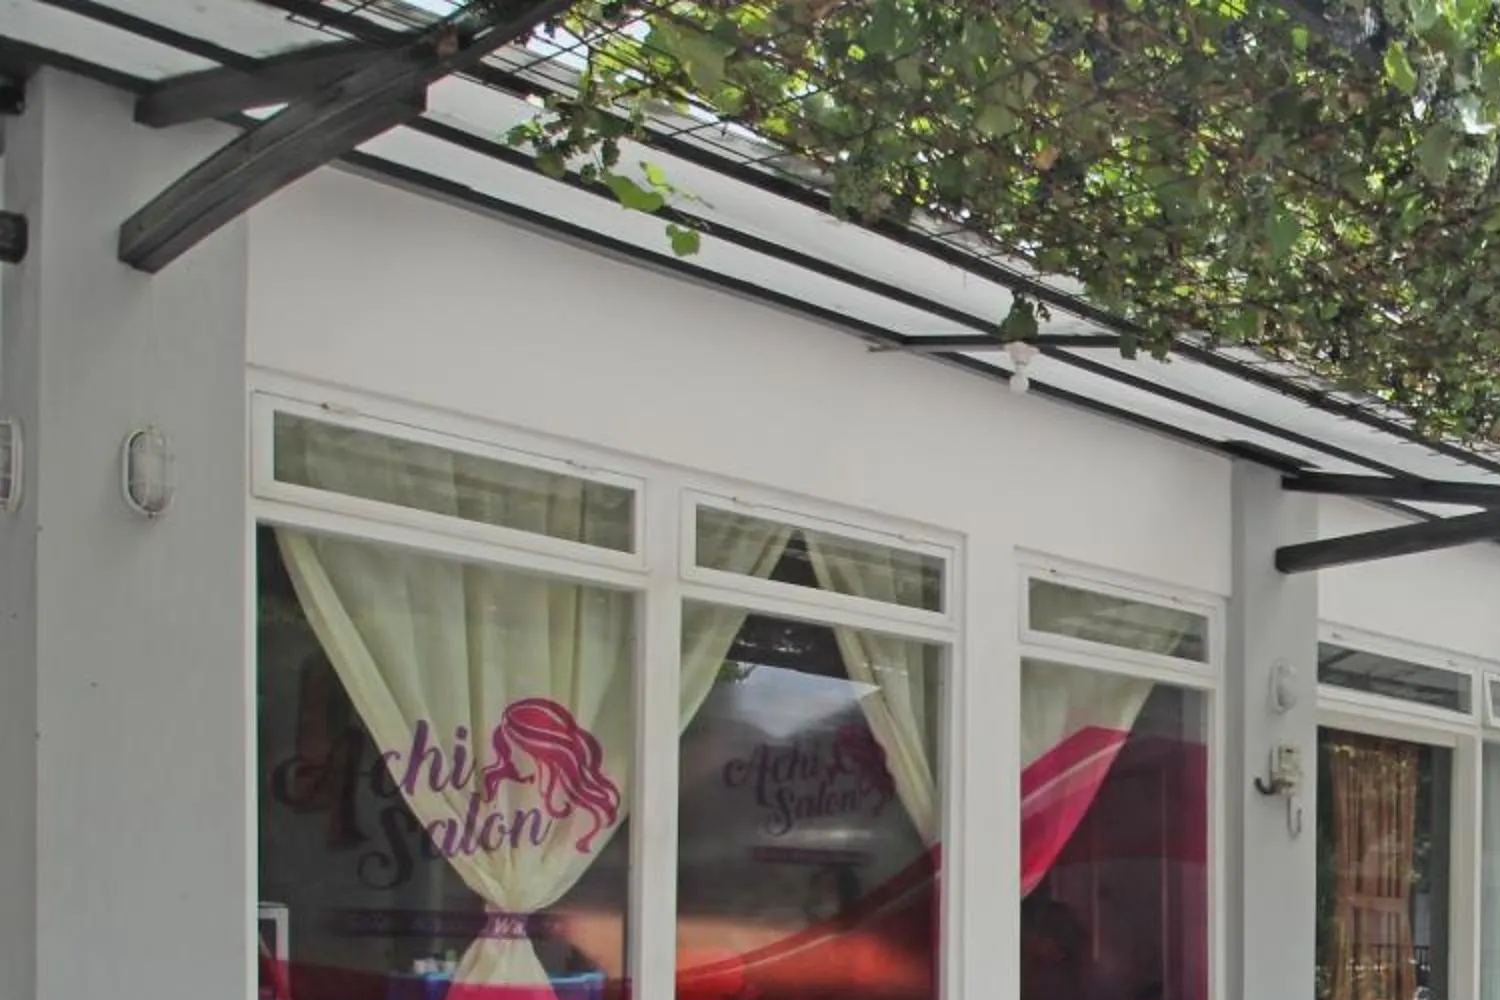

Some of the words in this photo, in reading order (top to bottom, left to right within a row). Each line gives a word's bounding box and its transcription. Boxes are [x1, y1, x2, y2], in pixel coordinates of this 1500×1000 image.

[273, 718, 477, 852] Achi
[722, 739, 822, 808] Achi
[766, 781, 860, 837] Salon
[357, 793, 552, 890] Salon
